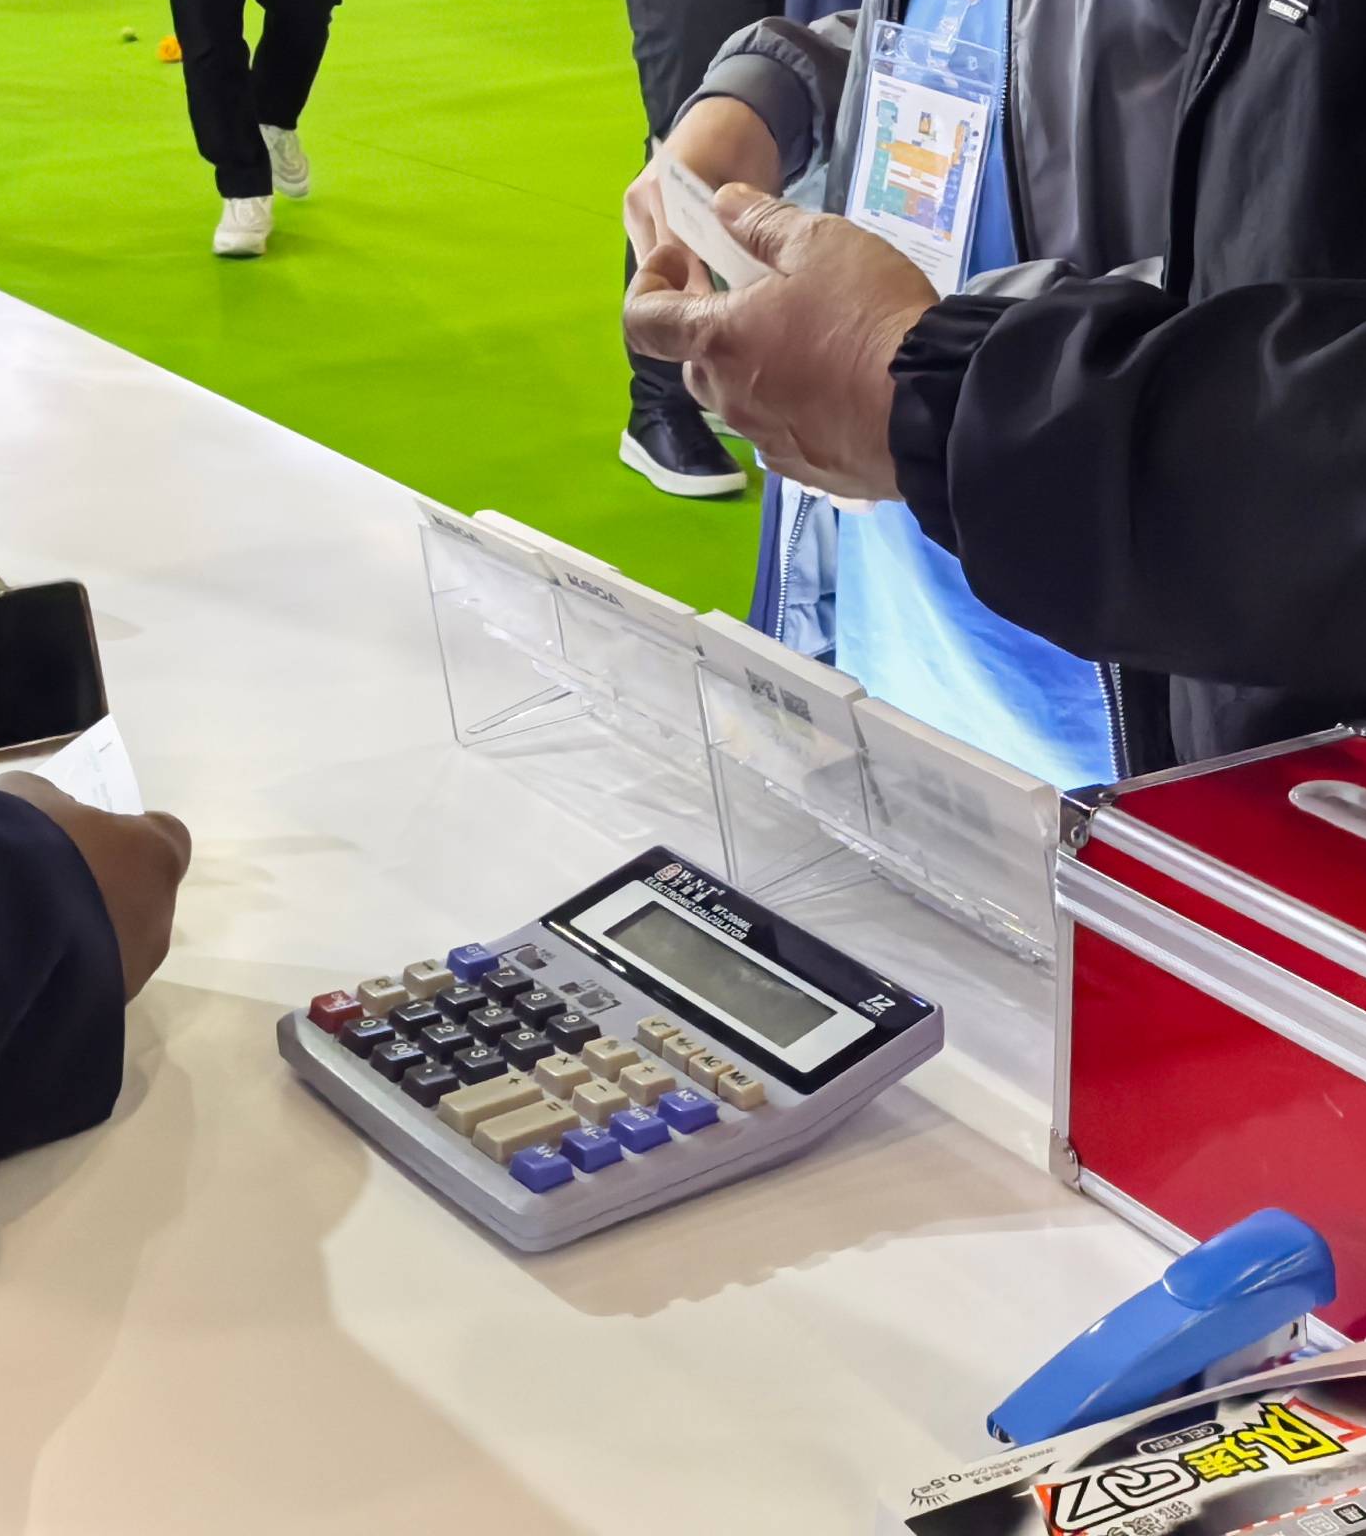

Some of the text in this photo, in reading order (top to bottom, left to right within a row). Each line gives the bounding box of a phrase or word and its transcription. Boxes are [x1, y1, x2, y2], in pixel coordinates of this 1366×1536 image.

[644, 877, 747, 940] ELECTRONIC CALCULATOR
[499, 969, 515, 978] 7
[454, 987, 469, 995] 4
[531, 992, 547, 1001] 8
[866, 994, 895, 1012] 12
[485, 1008, 502, 1017] 5
[563, 1015, 580, 1024] 9
[359, 1020, 377, 1029] 0
[438, 1025, 455, 1034] 2
[518, 1032, 535, 1041] 6
[391, 1043, 412, 1056] 00
[471, 1049, 488, 1058] 3
[1149, 1425, 1216, 1452] GEL PEN
